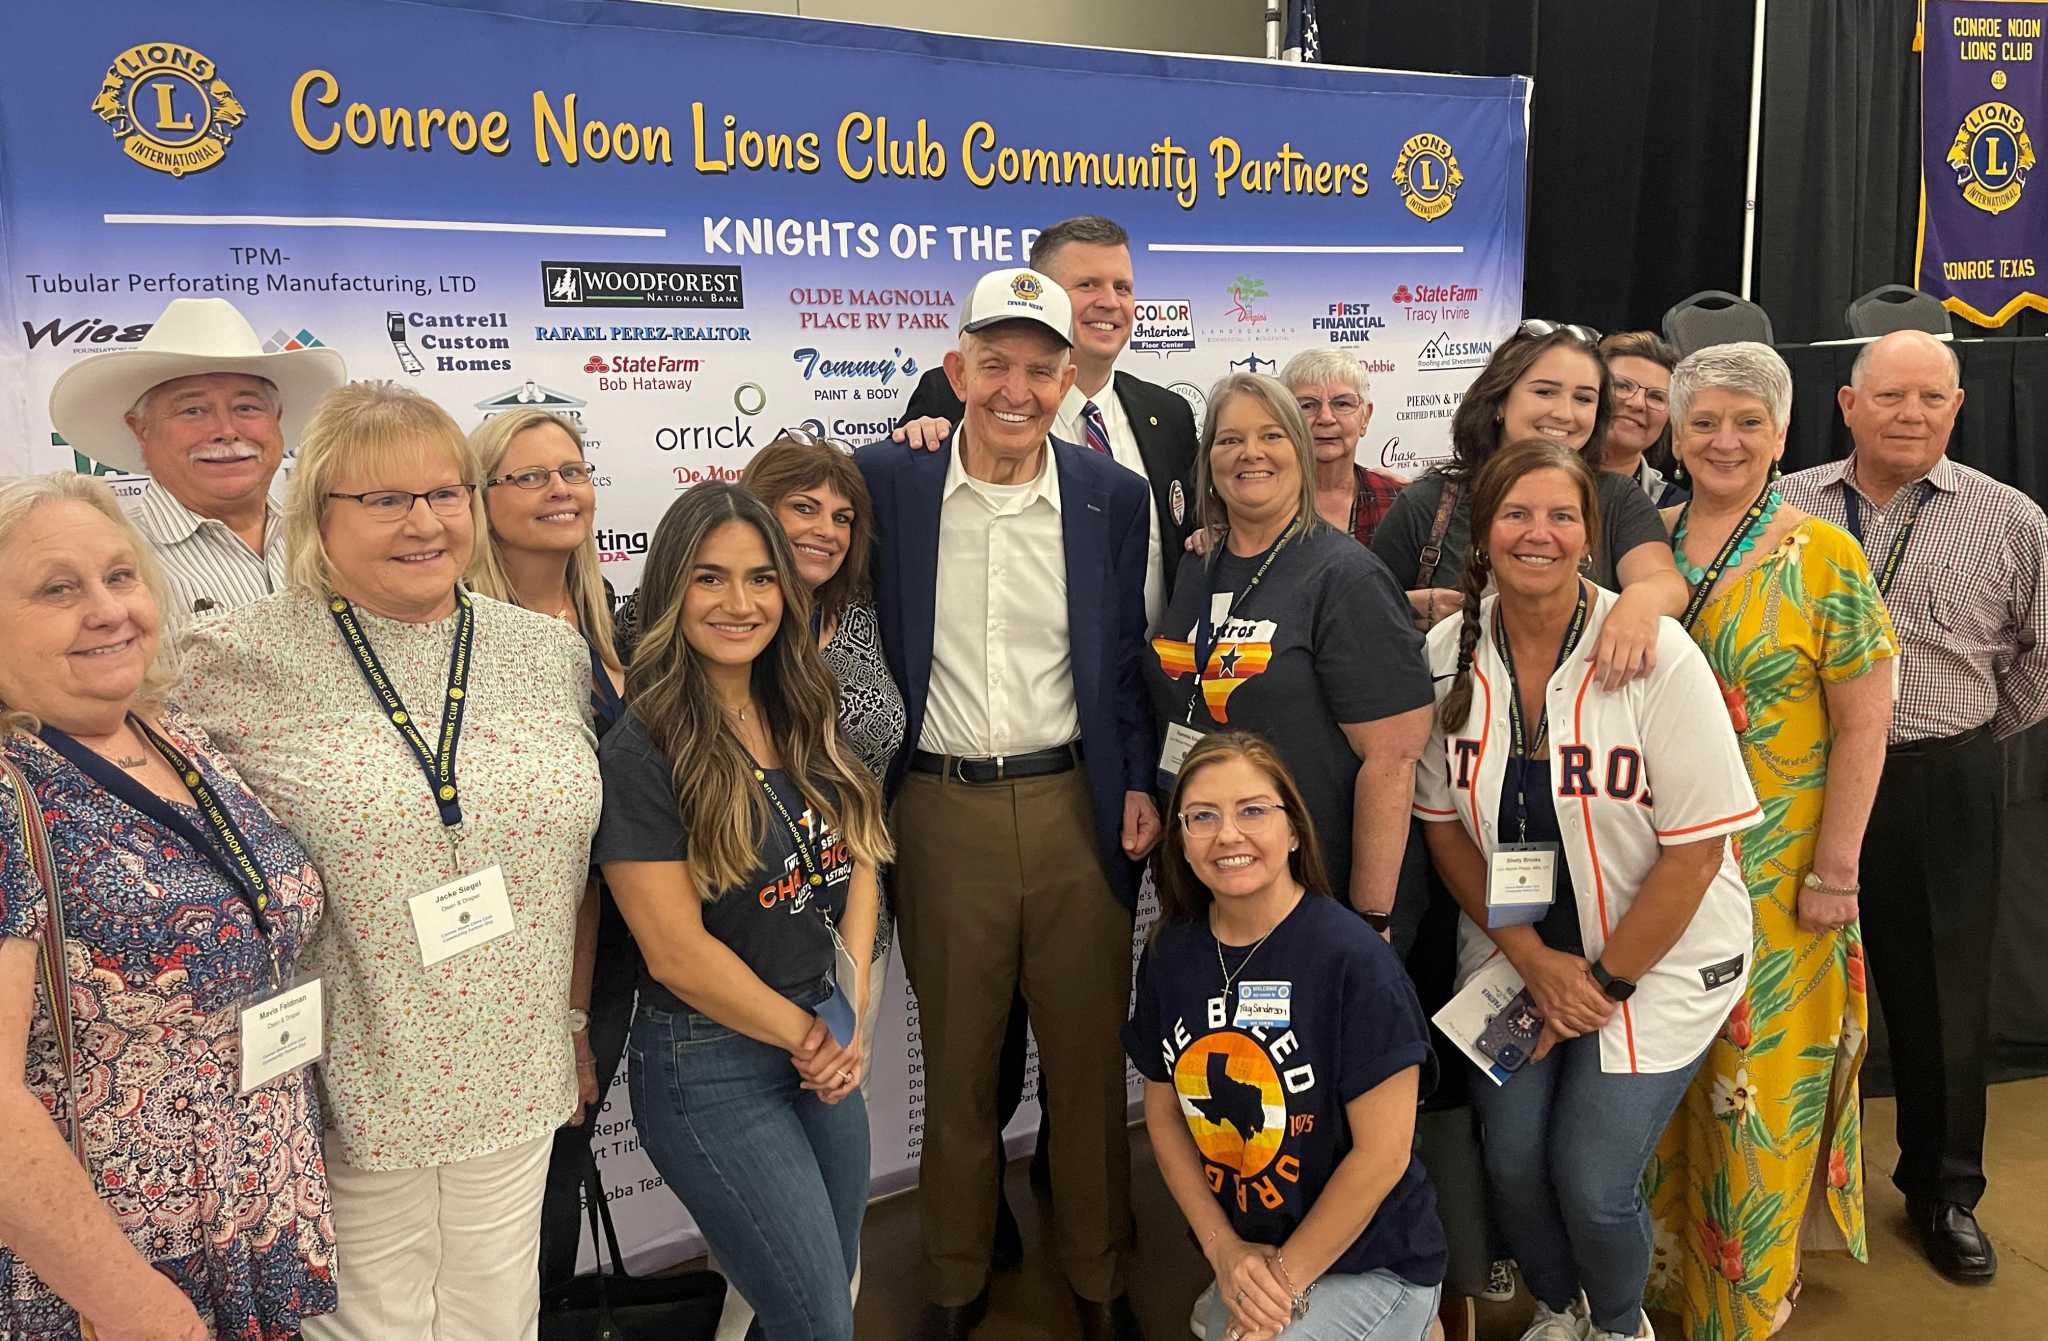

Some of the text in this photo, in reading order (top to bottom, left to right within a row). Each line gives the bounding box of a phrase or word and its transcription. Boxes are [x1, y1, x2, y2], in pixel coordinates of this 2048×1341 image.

[1953, 17, 2041, 37] CONROE NOON
[120, 46, 209, 76] LIONS
[1960, 42, 2033, 61] LIONS CLUB
[1969, 104, 2020, 129] LIONS
[291, 69, 1369, 210] Conroe Noon Lions Club Community Partners
[1407, 136, 1448, 154] LIONS
[131, 140, 218, 167] INTERNATIONAL
[1967, 185, 2018, 208] INTERNATIONAL
[1408, 198, 1449, 215] INTERNATIONAL
[703, 216, 880, 259] KNIGHTS
[889, 223, 938, 260] OF
[946, 224, 1013, 261] THE
[229, 247, 291, 266] TPM-
[1943, 258, 2036, 280] CONROE TEXAS
[26, 273, 477, 297] Tubular Perforating Manufacturing, LTD
[583, 271, 739, 292] WOODFOREST
[790, 288, 956, 306] OLDE MAGNOLIA
[1134, 304, 1189, 321] COLOR
[1328, 303, 1371, 316] FIRST
[1404, 306, 1471, 324] Tracy Irvine
[408, 312, 508, 328] Cantrell
[800, 312, 950, 330] PLACE RV PARK
[1312, 317, 1386, 330] FINANCIAL
[535, 325, 752, 341] RAFAEL PEREZ-REALTOR
[1133, 323, 1191, 338] Interiors
[1330, 329, 1371, 342] BANK
[421, 334, 510, 349] Custom
[1141, 341, 1159, 349] Floor
[1444, 341, 1492, 356] LESSMAN
[436, 356, 512, 372] Homes
[793, 347, 918, 386] Tommy's
[1359, 360, 1396, 373] Debbie
[599, 377, 692, 393] Bob Hataway
[814, 388, 900, 400] PAINT & BODY
[1406, 394, 1441, 407] PIERSON
[1444, 394, 1451, 405] &
[1396, 411, 1429, 422] CERTIFIED
[655, 416, 755, 451] orrick
[1381, 436, 1417, 468] Chase
[1715, 538, 1737, 569] COMMUNITY
[340, 613, 399, 709] CONROE NOON LIONS CLUB
[453, 644, 468, 686] COMMUNITY
[449, 702, 459, 720] CLUB
[403, 725, 434, 764] COMMUNITY
[763, 782, 778, 801] CLUB
[776, 800, 791, 824] LIONS
[197, 786, 264, 890] CONROE NOON LIONS CLUB
[788, 822, 802, 845] NOON
[798, 844, 815, 872] CONROE
[1289, 1114, 1315, 1137] 1975
